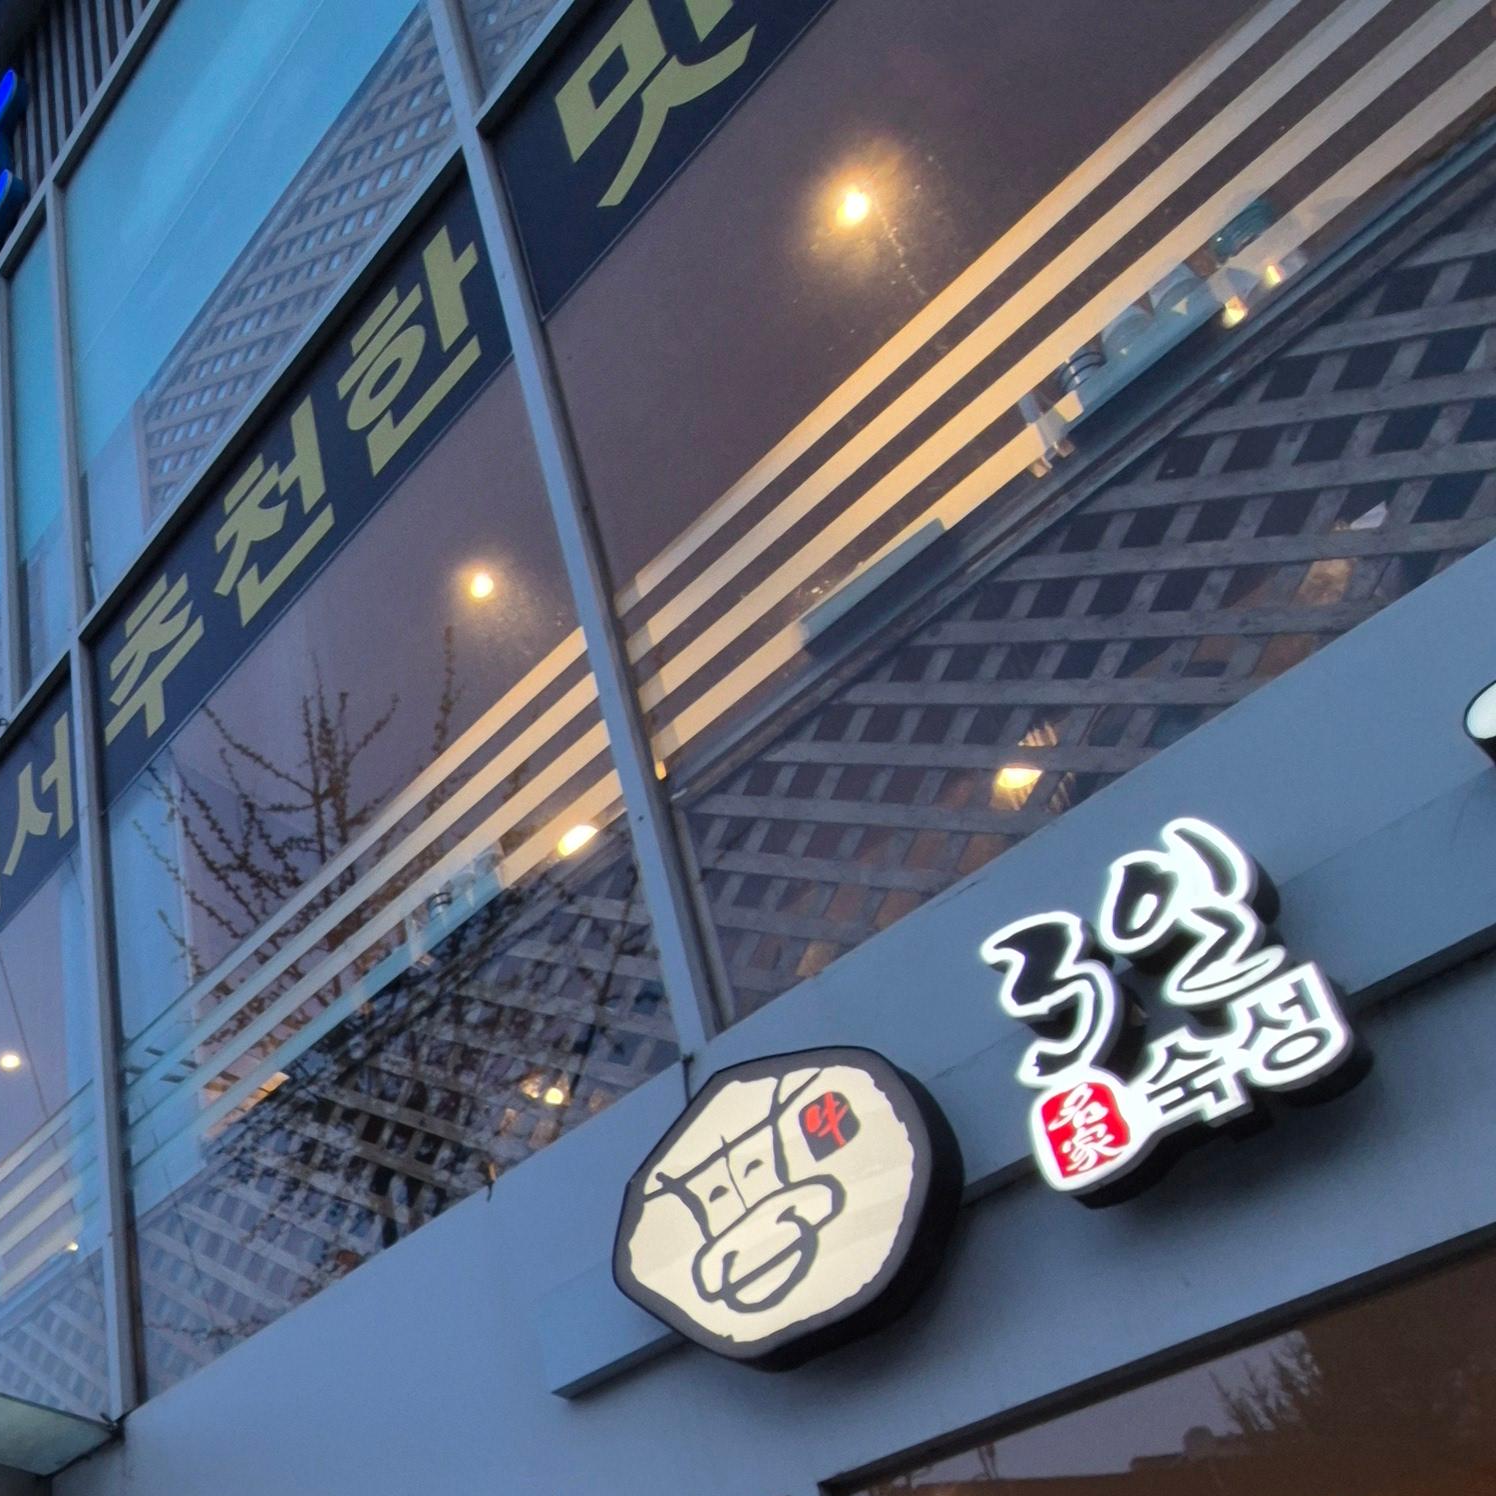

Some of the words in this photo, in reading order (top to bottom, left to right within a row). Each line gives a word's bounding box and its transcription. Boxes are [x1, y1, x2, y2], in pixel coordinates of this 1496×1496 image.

[105, 225, 481, 746] 추천한
[984, 818, 1287, 1086] 3일
[1142, 962, 1354, 1130] 숙성
